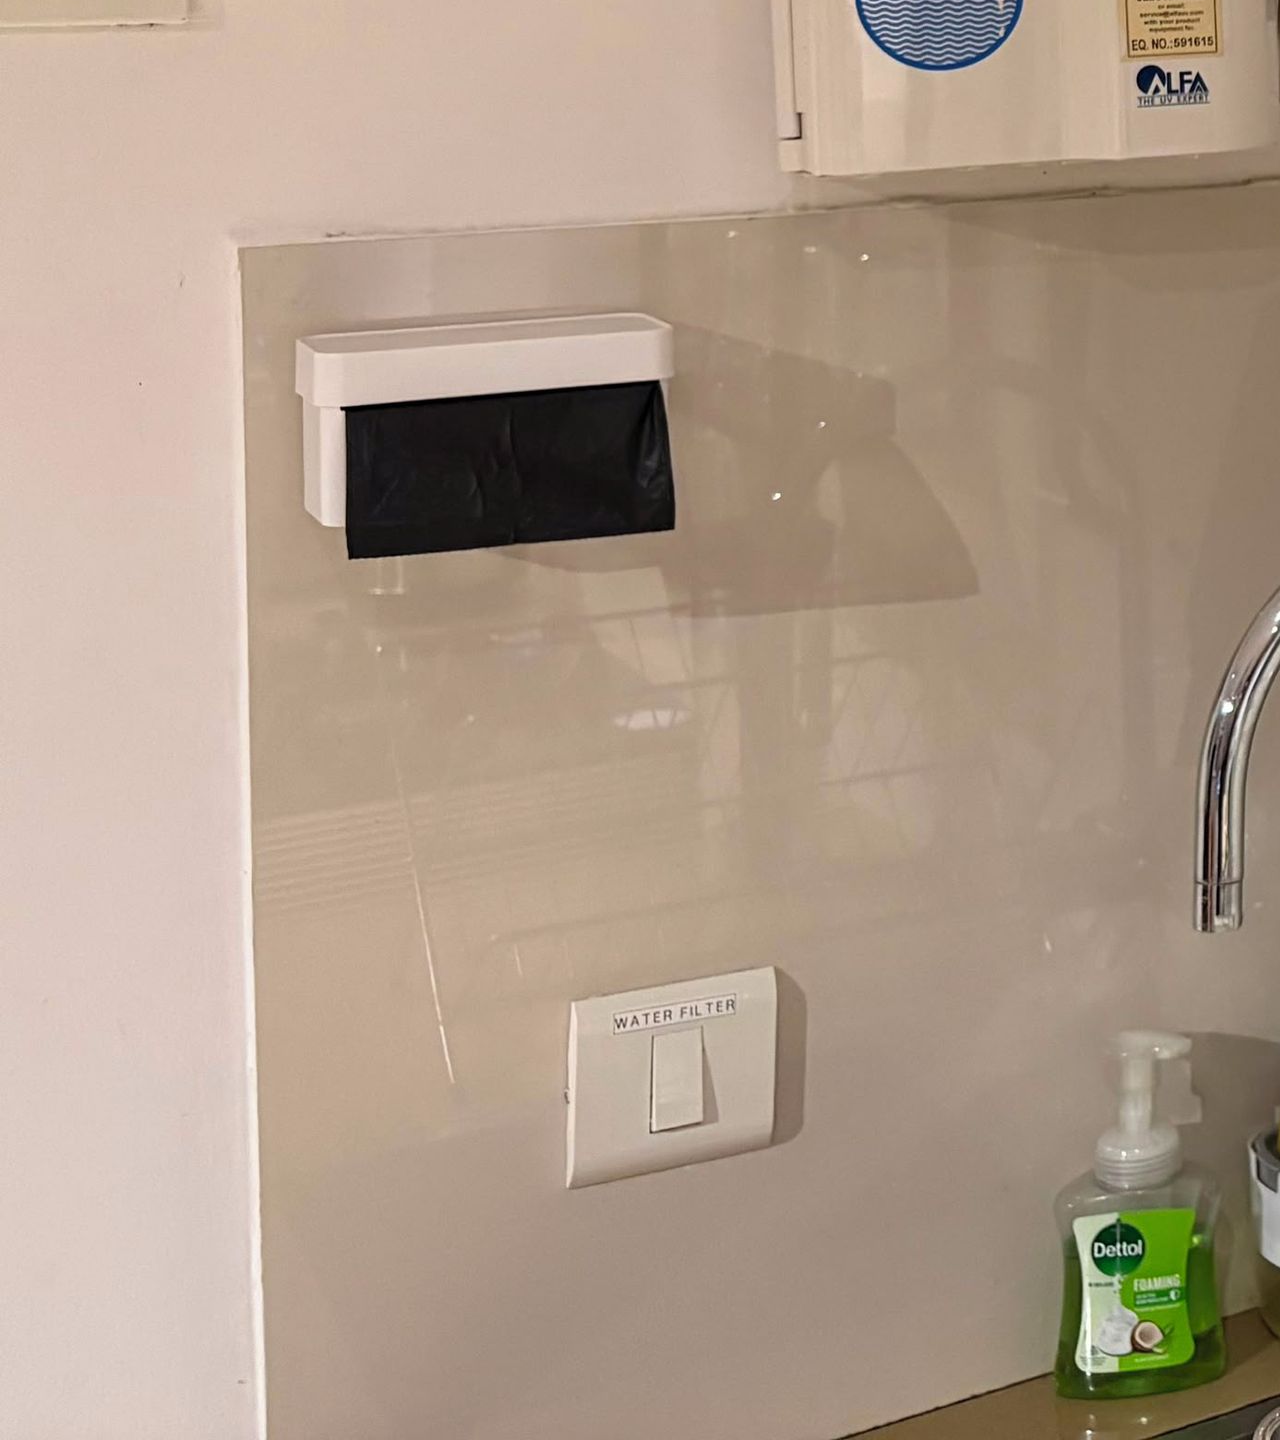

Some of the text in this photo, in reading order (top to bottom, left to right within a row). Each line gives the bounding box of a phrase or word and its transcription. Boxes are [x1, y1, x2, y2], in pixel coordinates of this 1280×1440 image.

[1137, 93, 1209, 106] THE UV EXPERT
[614, 998, 736, 1030] WATER FILTER
[1093, 1239, 1143, 1258] Dettol
[1133, 1274, 1181, 1292] FOAMING
